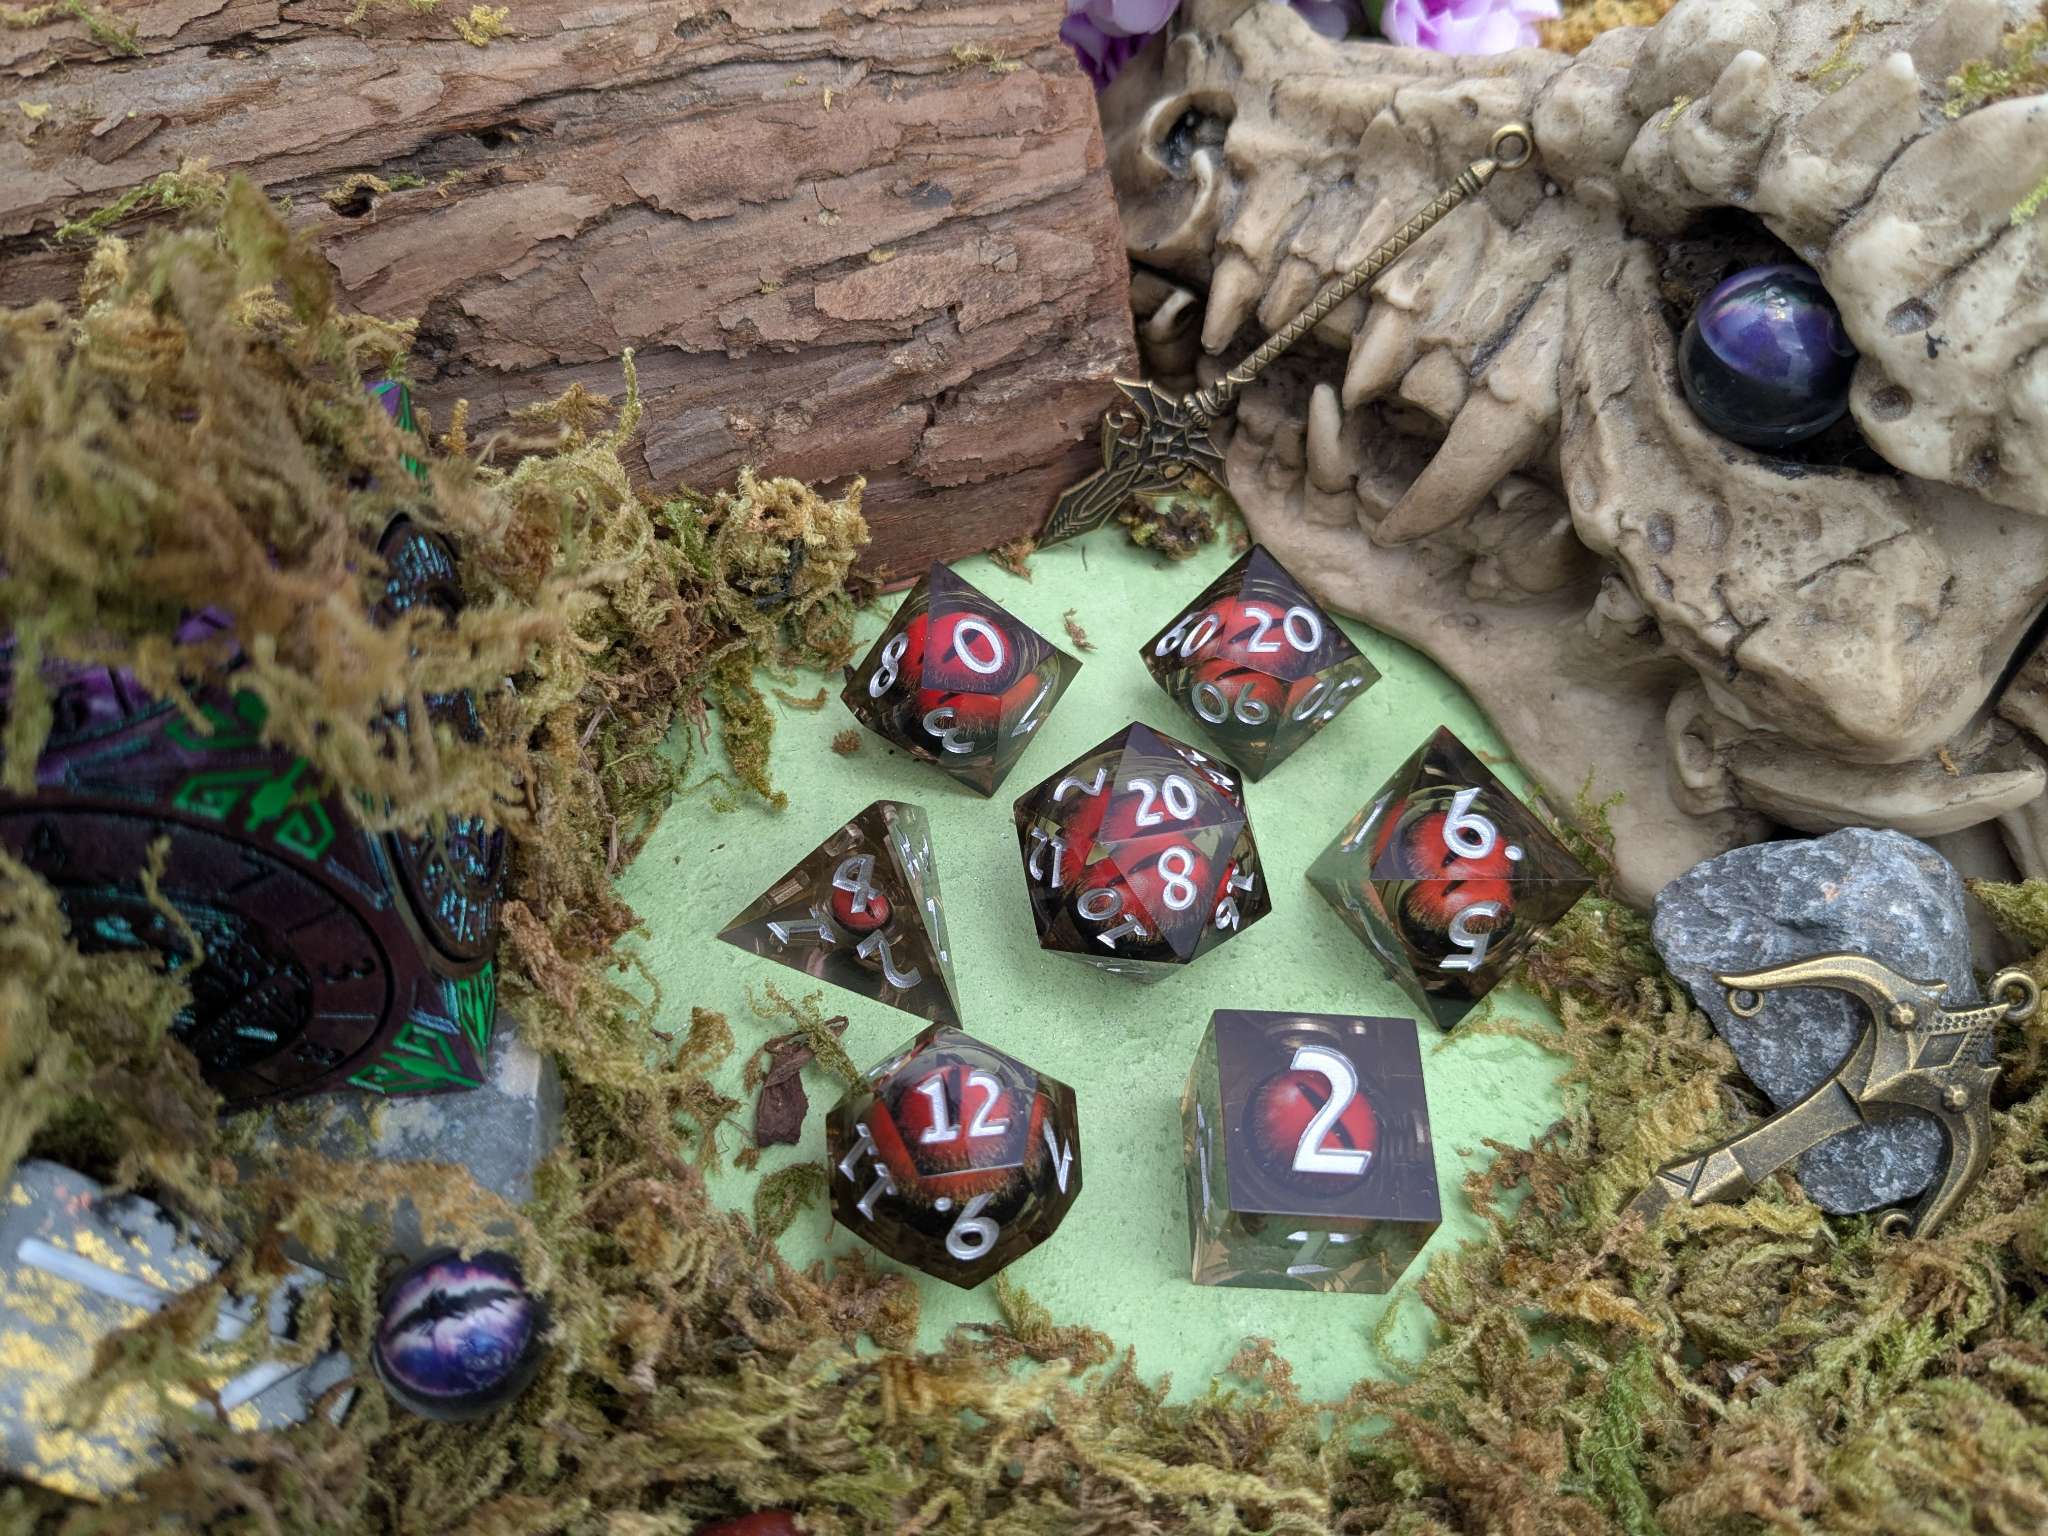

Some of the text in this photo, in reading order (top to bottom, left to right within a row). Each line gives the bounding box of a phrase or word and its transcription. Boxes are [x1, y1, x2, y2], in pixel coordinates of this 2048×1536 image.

[953, 616, 1005, 675] 0
[1155, 610, 1221, 658] 60
[1243, 606, 1323, 653] 20
[869, 631, 909, 698] 8
[1127, 774, 1198, 827] 20
[1157, 844, 1198, 911] 8
[917, 1068, 1011, 1145] 12
[1289, 1044, 1373, 1176] 2
